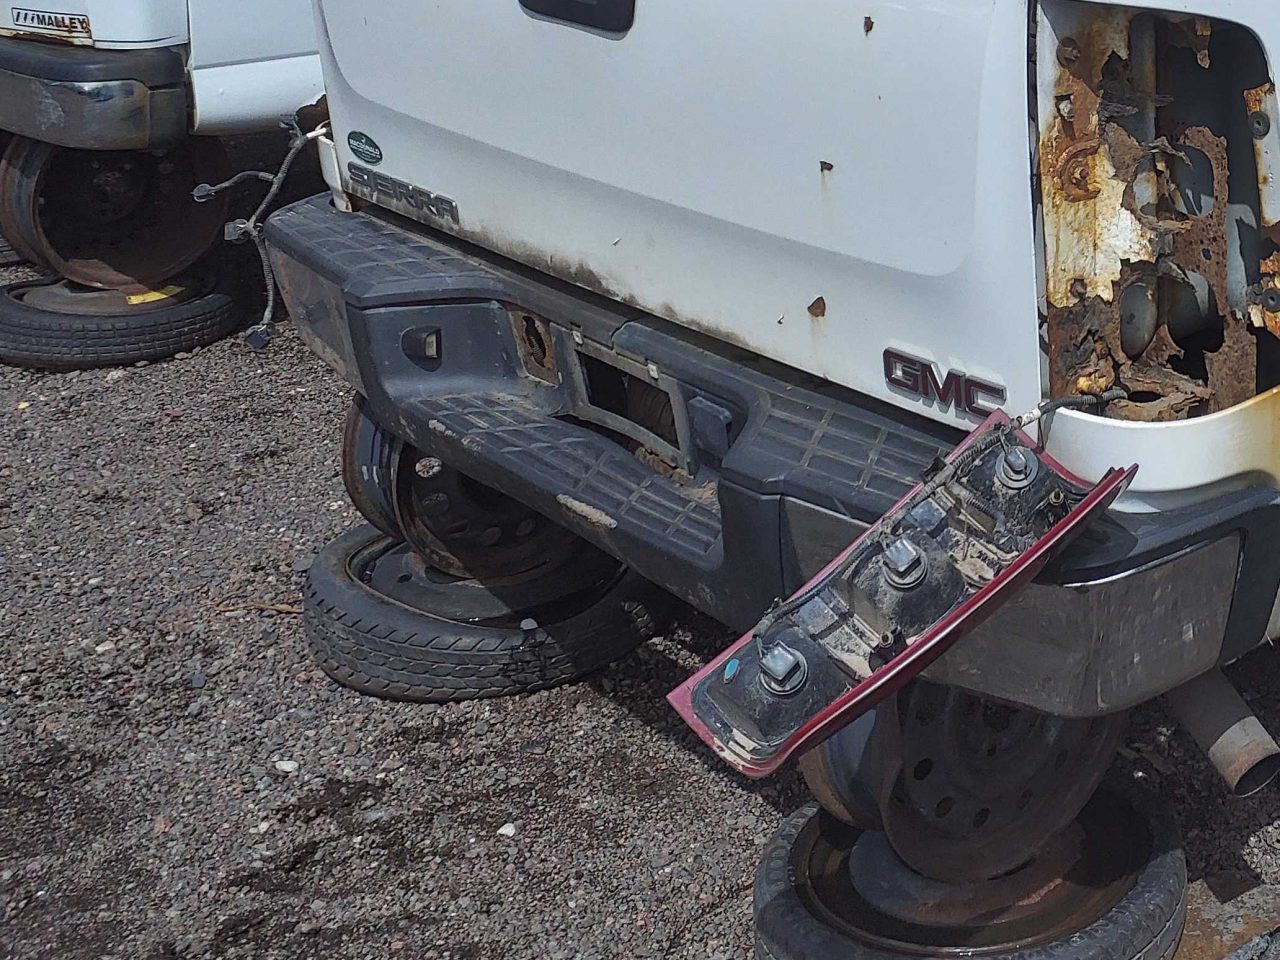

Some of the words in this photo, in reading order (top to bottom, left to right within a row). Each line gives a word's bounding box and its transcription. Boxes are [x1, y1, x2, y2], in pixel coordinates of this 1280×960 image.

[36, 13, 90, 32] MALLEY
[347, 161, 460, 226] SIERRA
[883, 346, 1008, 420] GMC
